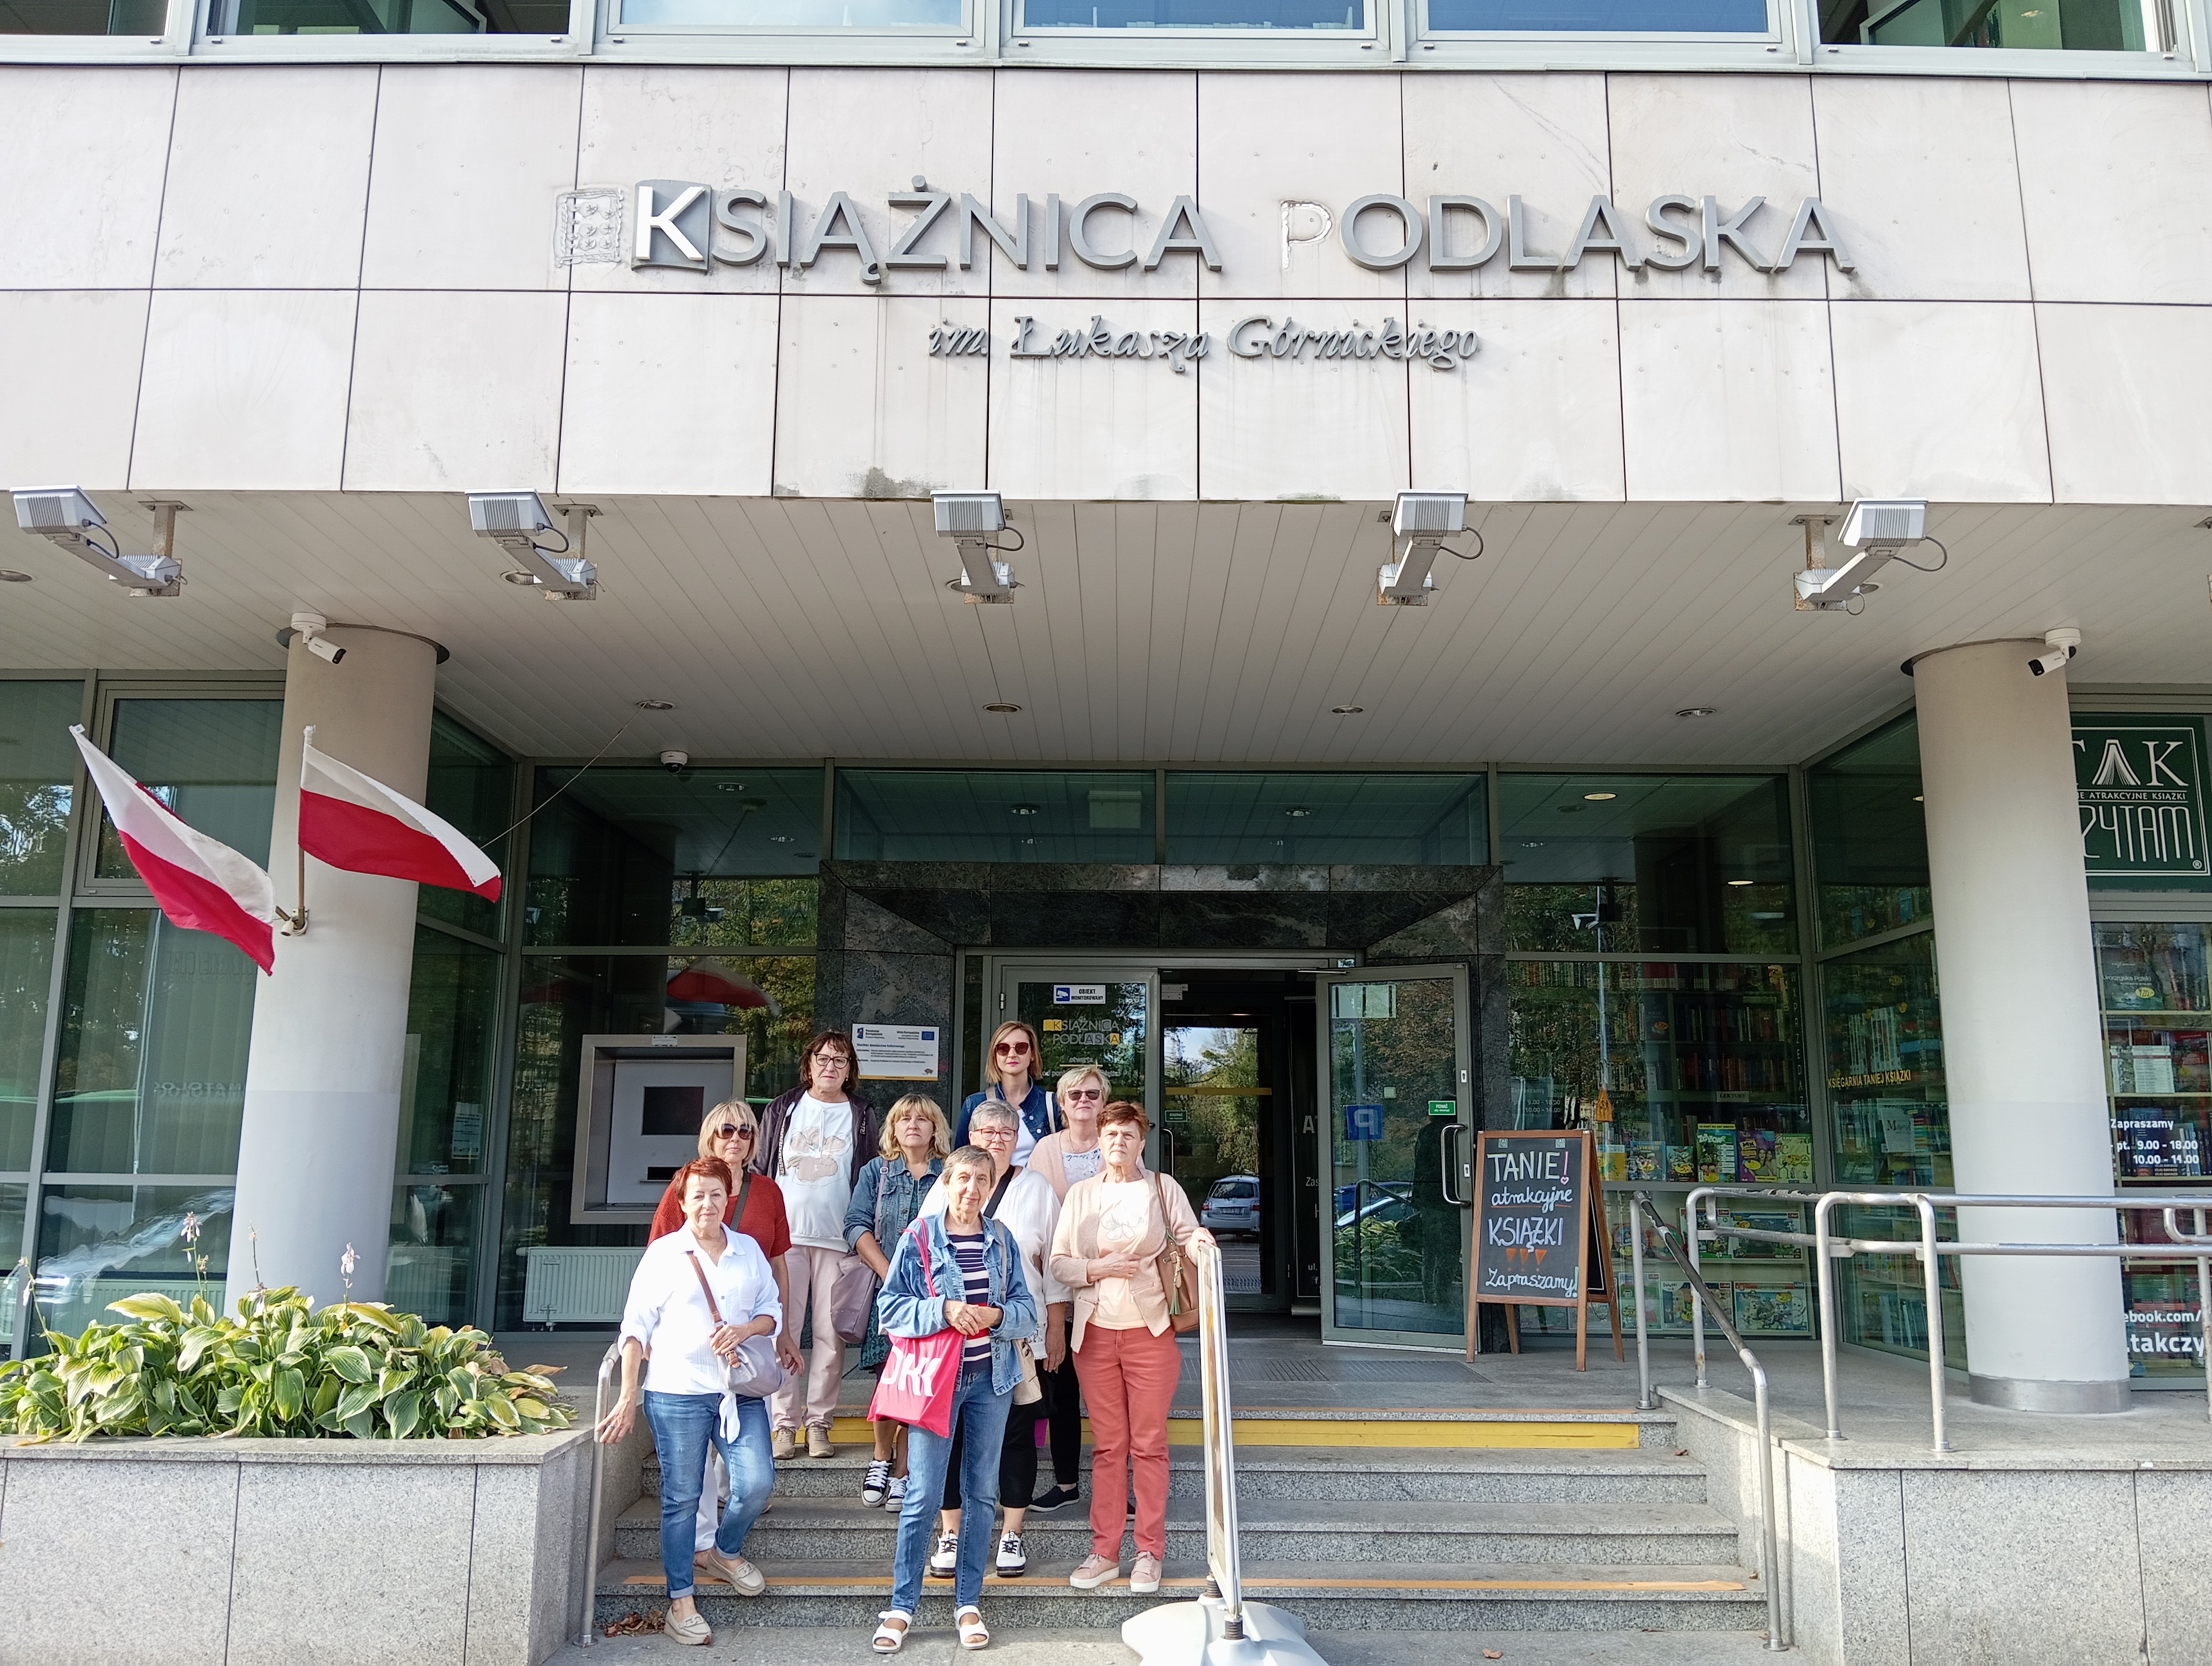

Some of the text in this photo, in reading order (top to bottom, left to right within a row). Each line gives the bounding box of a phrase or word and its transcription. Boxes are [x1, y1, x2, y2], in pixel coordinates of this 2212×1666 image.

[635, 175, 1856, 286] KSIĄŻNICA PODLASKA
[928, 315, 1480, 374] im. Łukasza Górnickiego
[2089, 792, 2147, 800] ATRAKCYJNE
[1052, 1033, 1120, 1045] PODLASKA
[1827, 1069, 1911, 1090] KSIĘGARNIA TANIEJ KSIĄŻKI
[2110, 1118, 2174, 1131] Zapraszamy
[2117, 1140, 2131, 1152] pt.
[2137, 1140, 2160, 1150] 9.00
[2169, 1140, 2198, 1150] 18.00
[1487, 1151, 1568, 1185] TANIE!
[2133, 1155, 2161, 1164] 10.00
[2171, 1155, 2200, 1164] 14.00
[1491, 1186, 1573, 1214] atrakcyjne
[1488, 1217, 1564, 1253] KSIĄŻKI
[1486, 1266, 1579, 1298] Zapraszamy!
